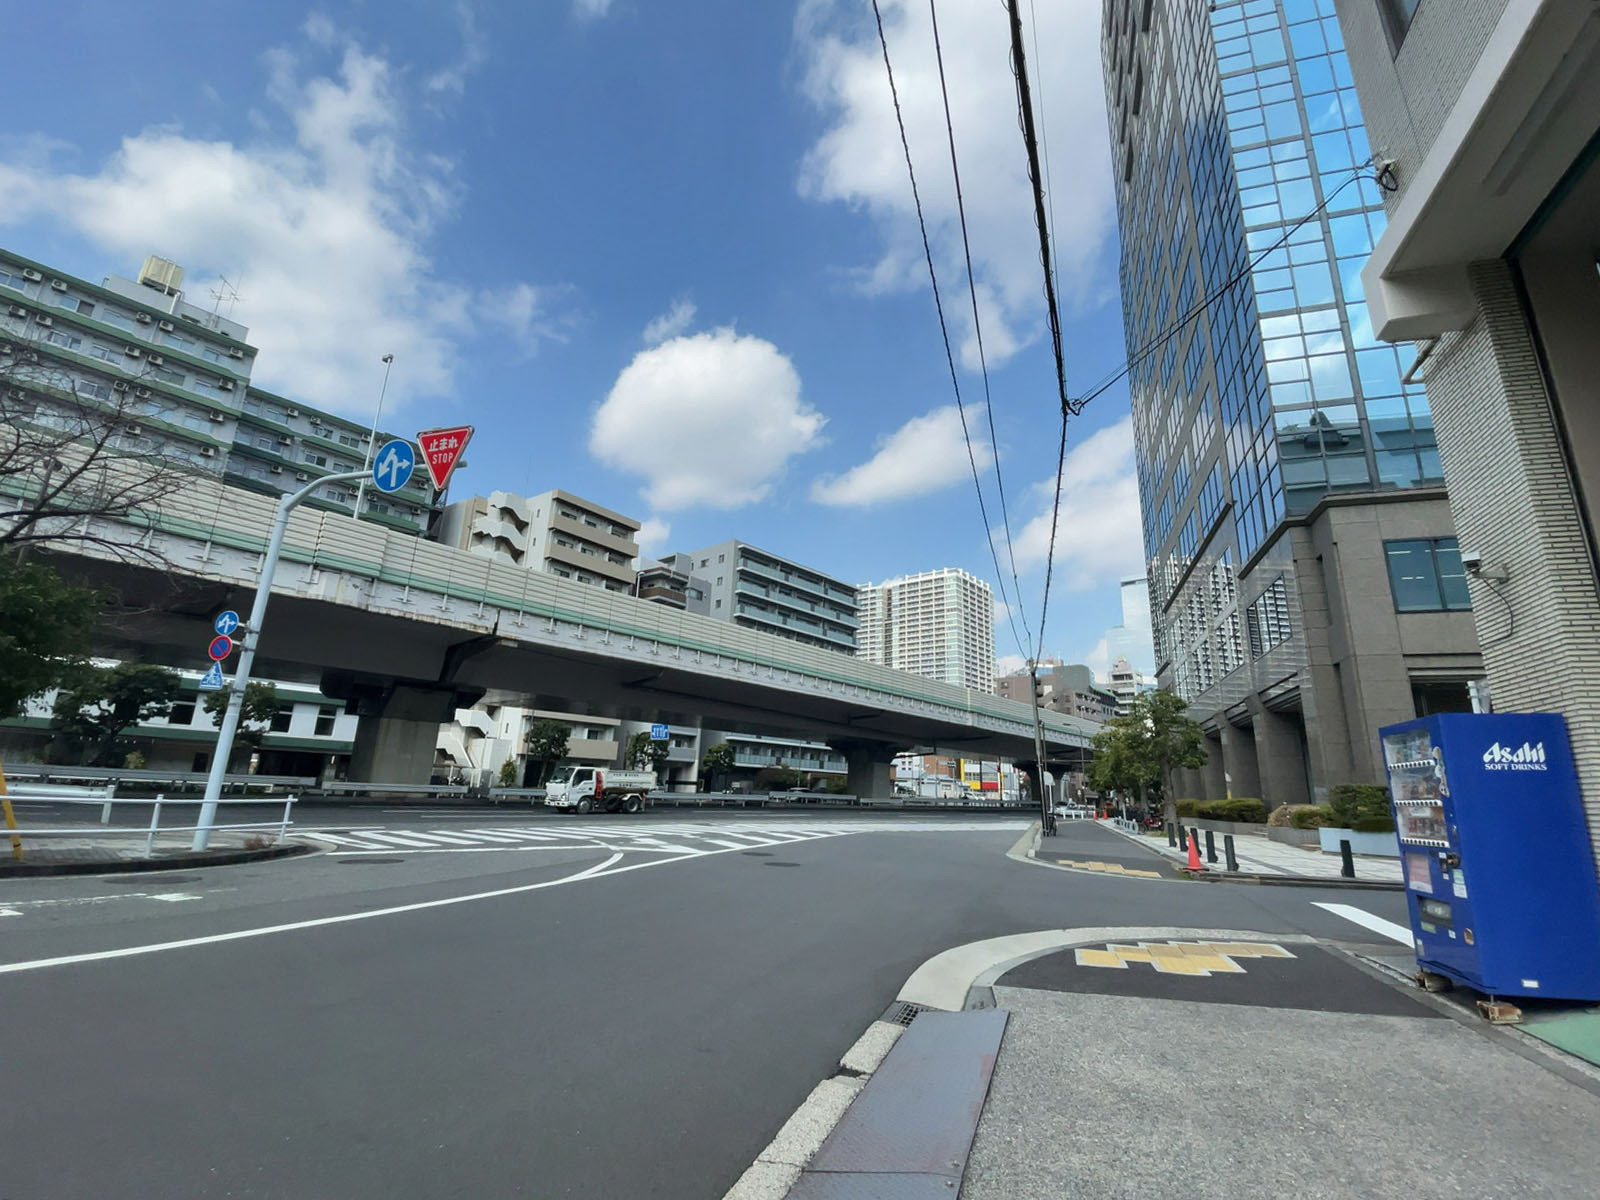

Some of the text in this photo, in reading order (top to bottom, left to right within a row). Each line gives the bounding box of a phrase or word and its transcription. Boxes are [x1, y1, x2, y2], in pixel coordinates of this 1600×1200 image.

[428, 436, 458, 452] 止まれ
[432, 452, 453, 464] STOP
[1483, 742, 1545, 762] Asahi
